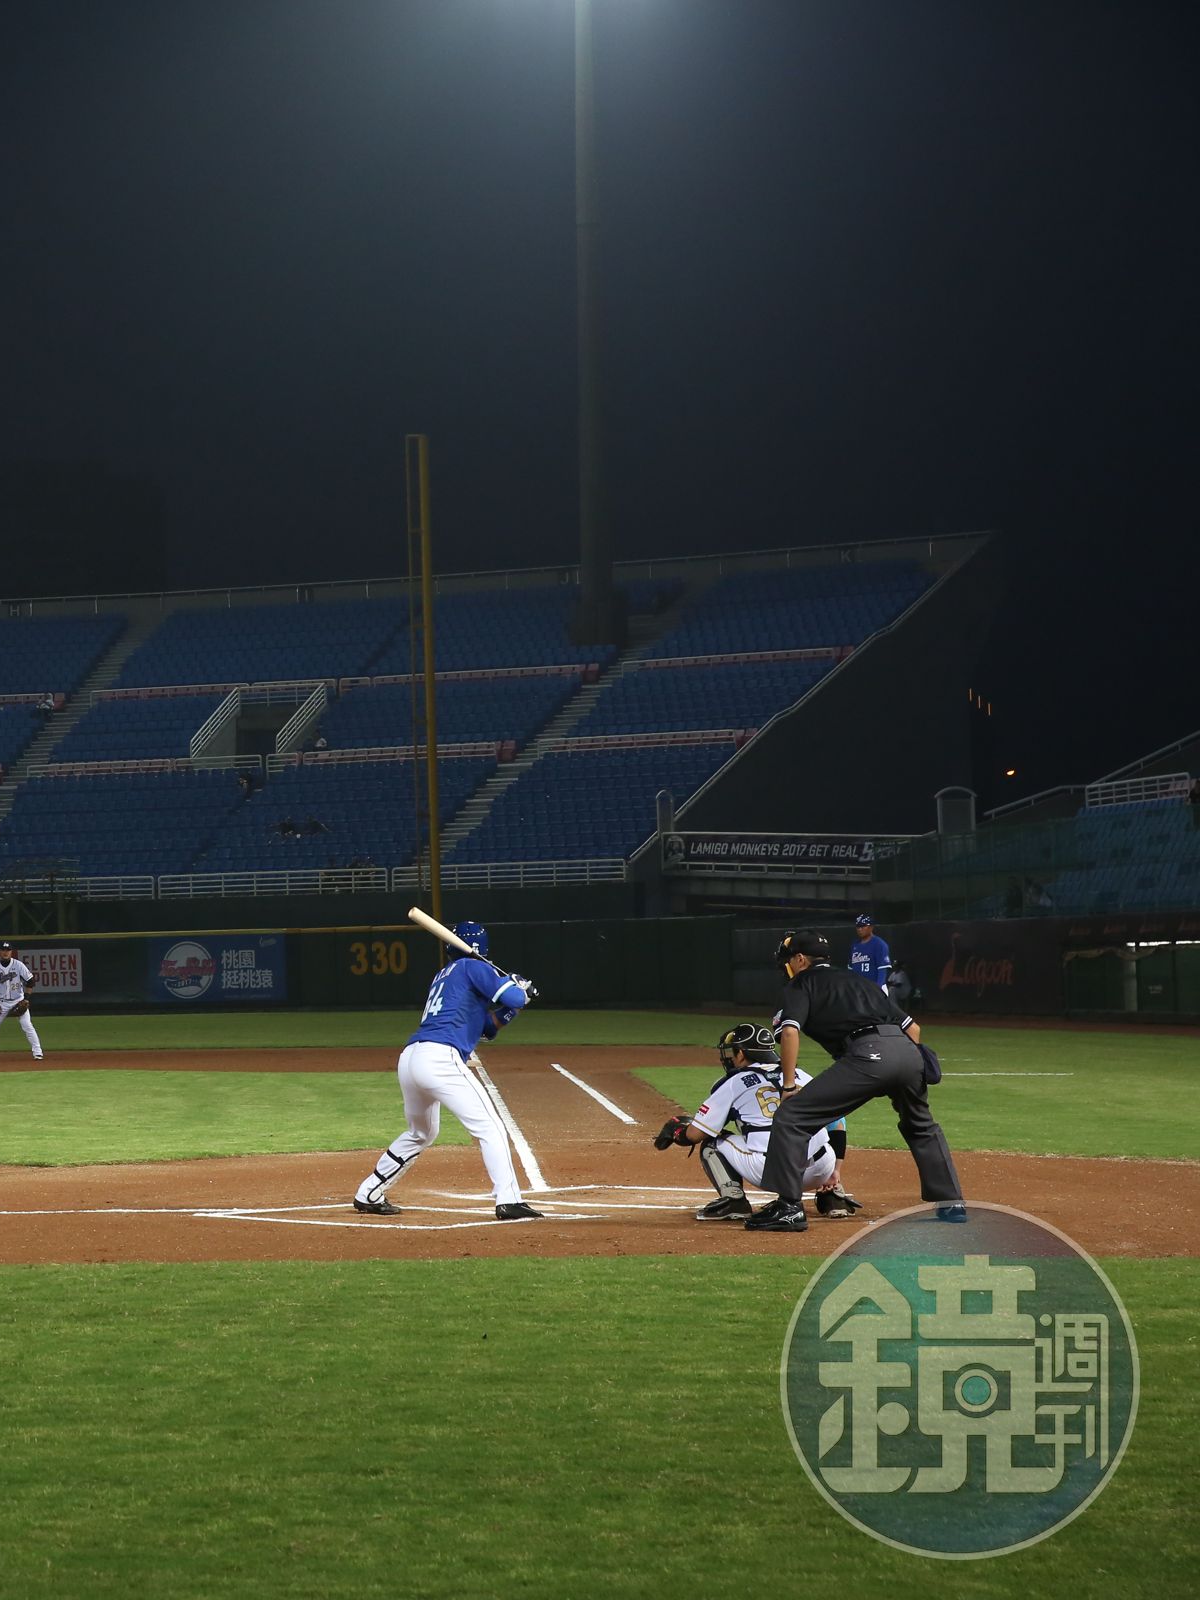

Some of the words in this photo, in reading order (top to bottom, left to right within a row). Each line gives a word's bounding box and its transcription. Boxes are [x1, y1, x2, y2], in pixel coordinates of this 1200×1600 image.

[9, 605, 20, 617] H
[690, 841, 728, 856] LAMIGO
[730, 842, 780, 857] MONKEYS
[782, 843, 807, 857] 2017
[809, 844, 829, 858] GET
[832, 845, 859, 858] REAL
[22, 954, 77, 971] ELEVEN
[221, 949, 256, 969] 桃園
[351, 941, 408, 976] 330
[861, 963, 870, 972] 13
[10, 983, 20, 991] 29
[33, 971, 78, 987] PORTS
[221, 968, 273, 989] 挺桃猿
[755, 1085, 785, 1119] 6
